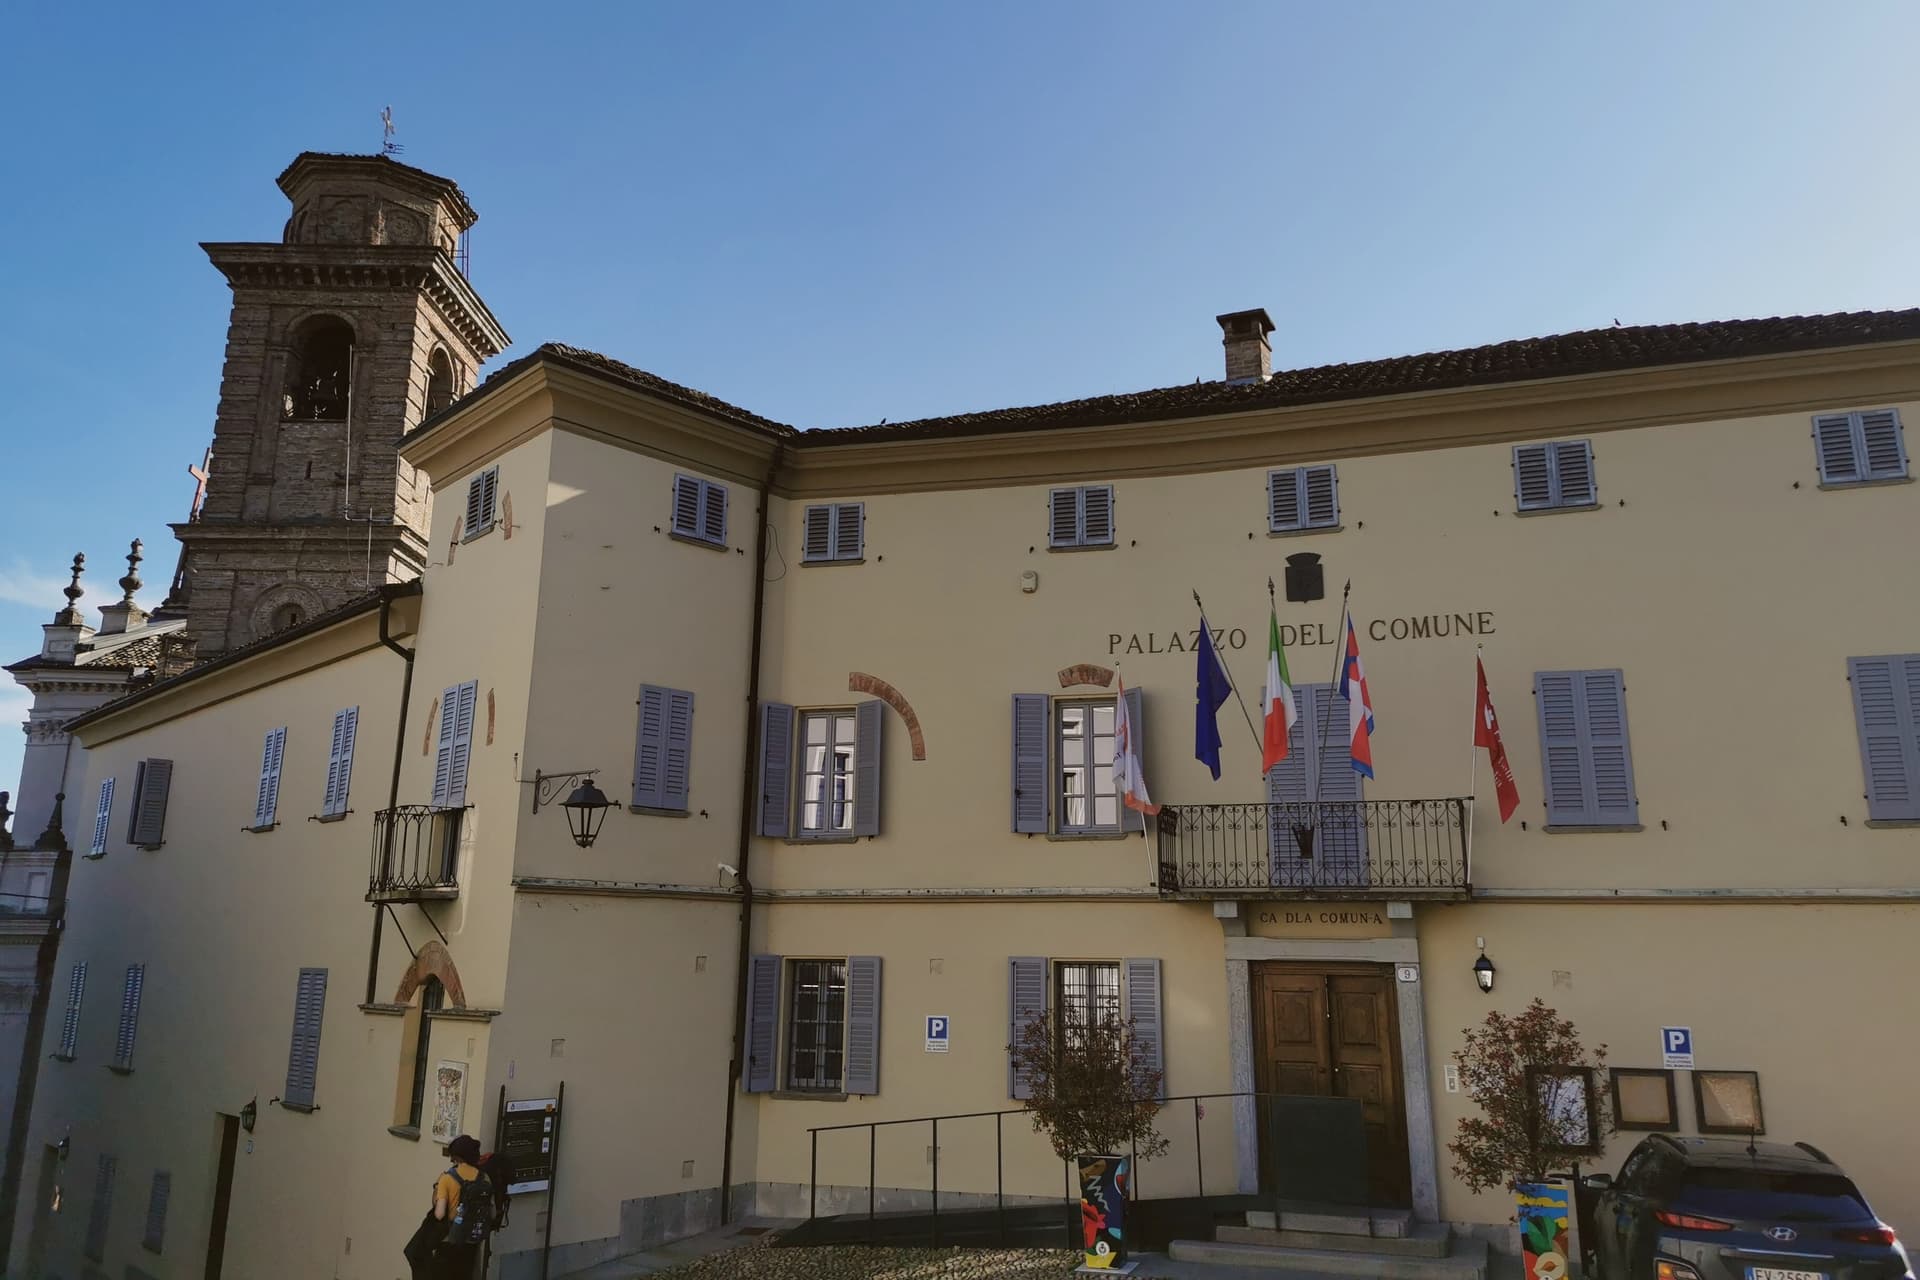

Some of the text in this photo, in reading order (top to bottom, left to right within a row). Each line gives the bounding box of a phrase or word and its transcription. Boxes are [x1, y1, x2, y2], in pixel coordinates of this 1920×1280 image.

[1108, 611, 1496, 655] PALAZZO DEL COMUNE
[1260, 912, 1277, 924] CA
[1286, 912, 1313, 924] DLA
[1404, 969, 1411, 980] 9
[931, 1019, 944, 1037] P
[1669, 1031, 1685, 1051] P
